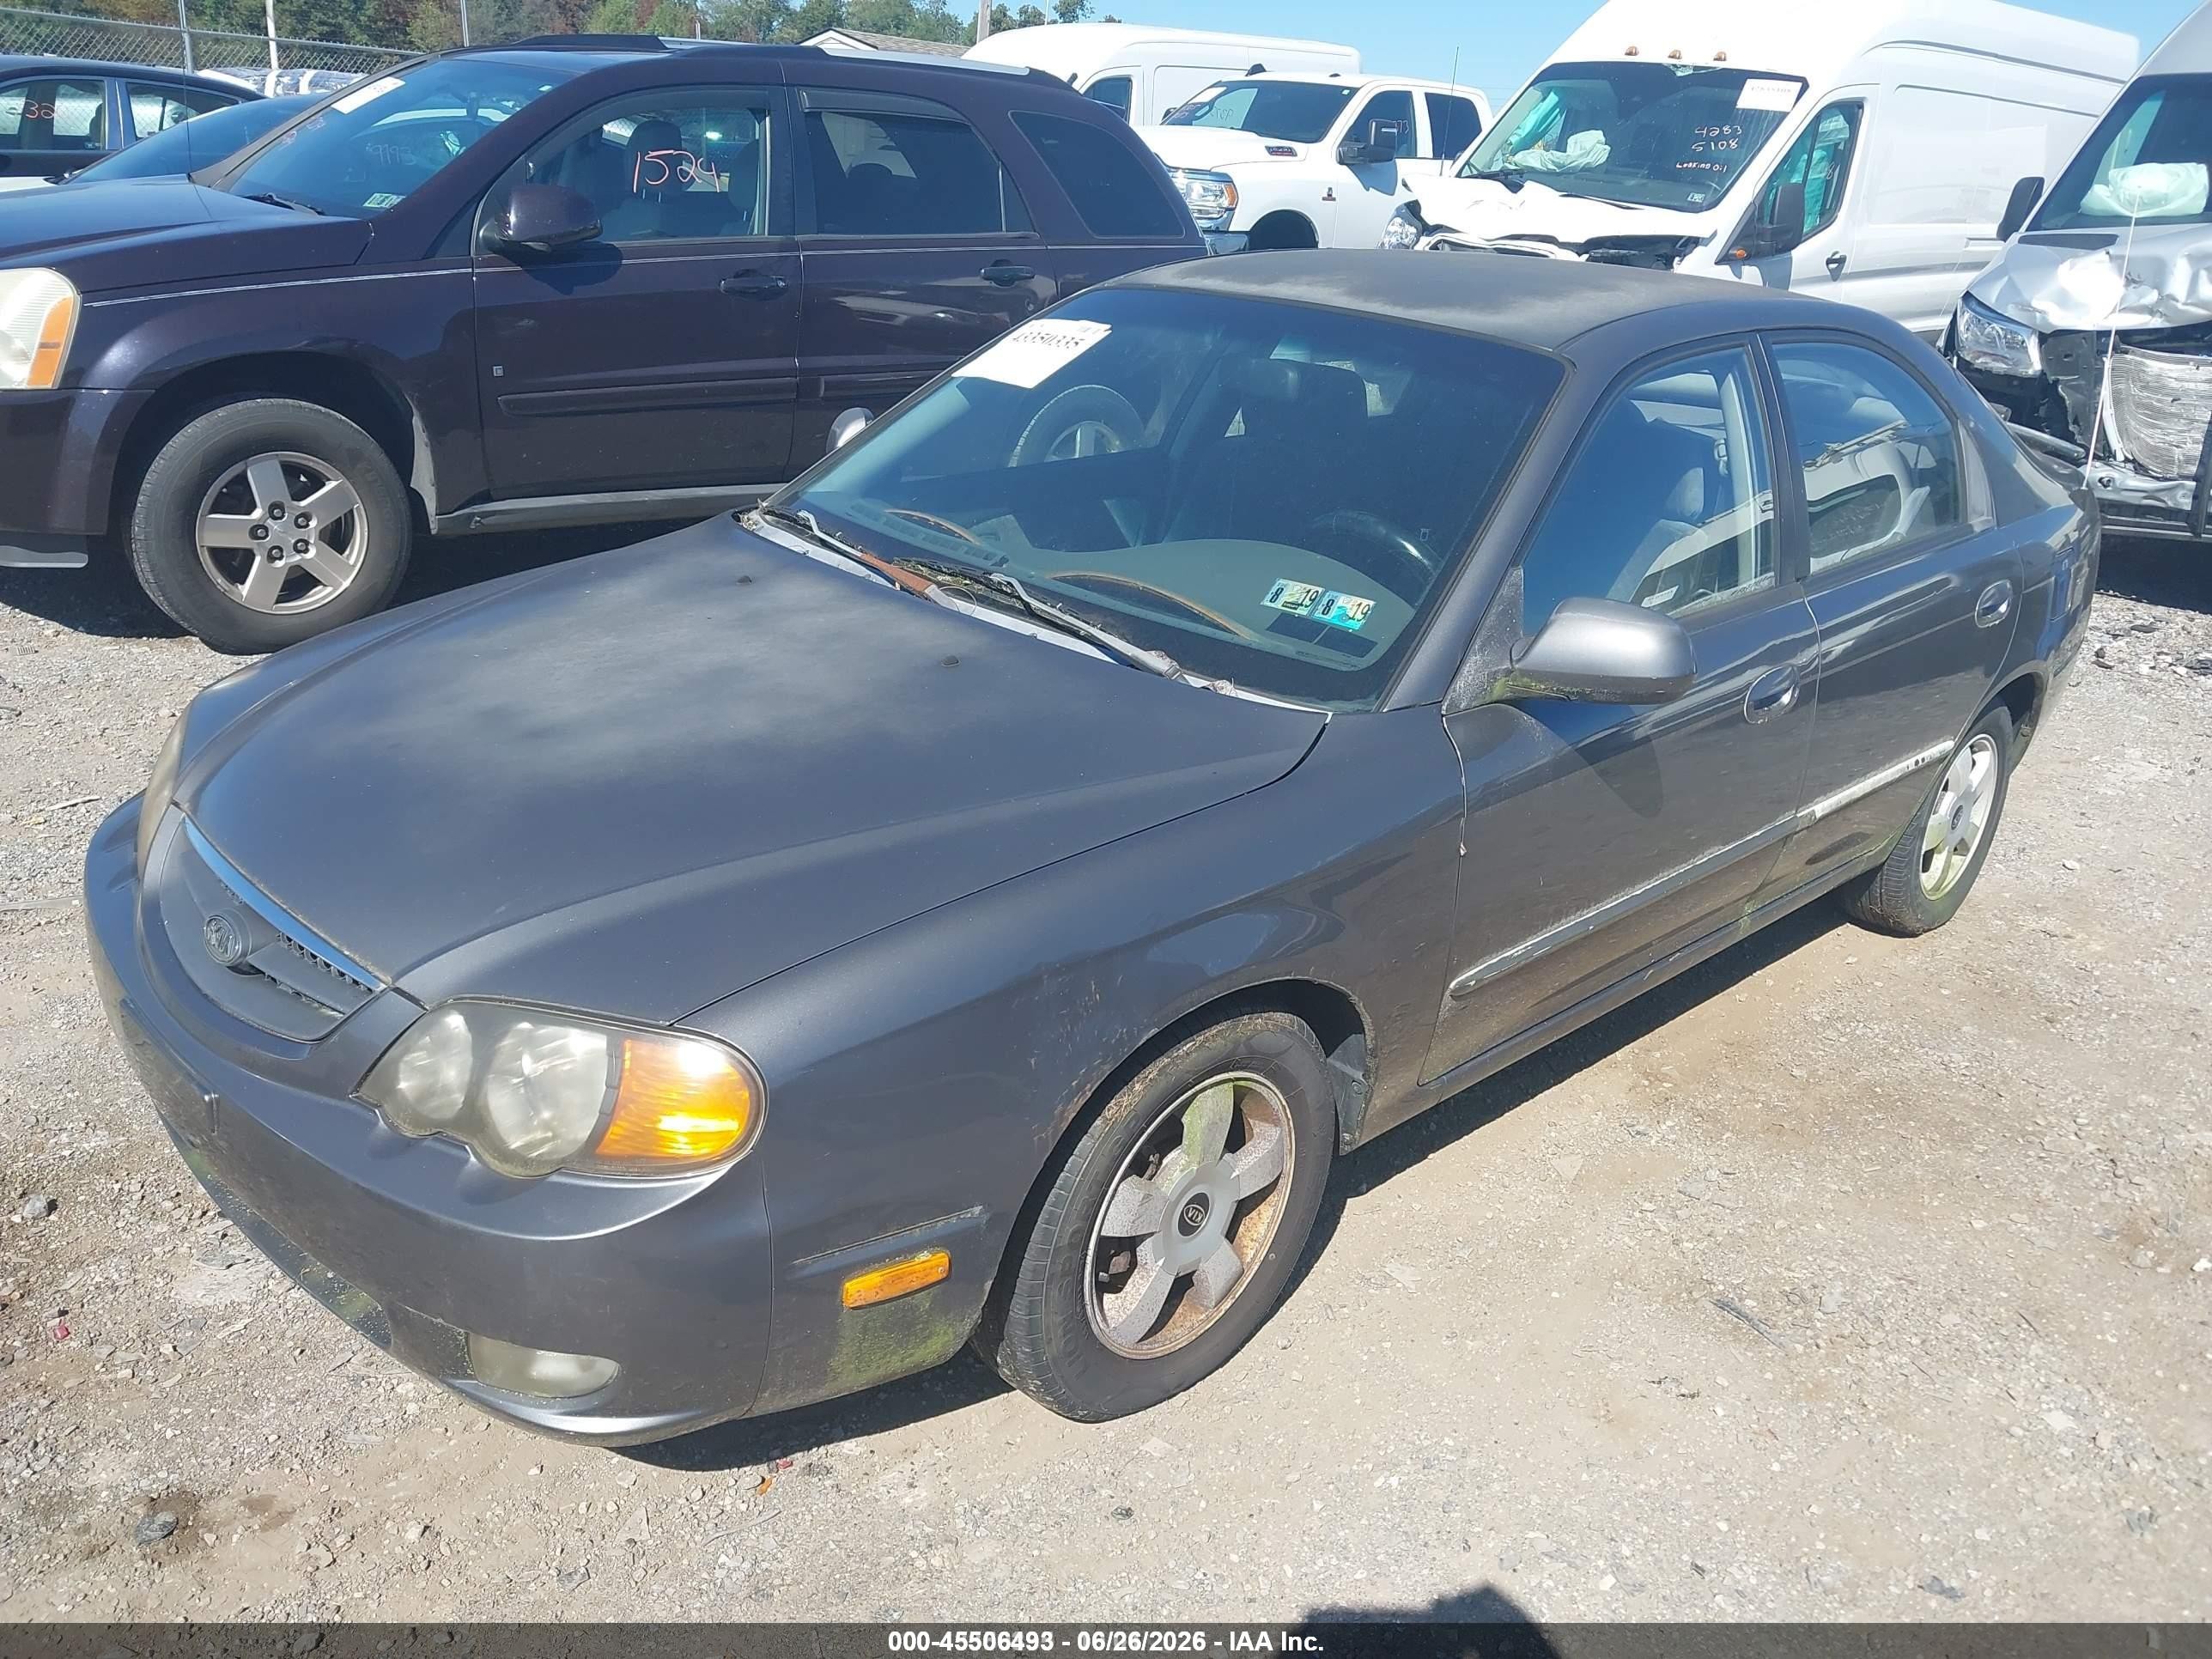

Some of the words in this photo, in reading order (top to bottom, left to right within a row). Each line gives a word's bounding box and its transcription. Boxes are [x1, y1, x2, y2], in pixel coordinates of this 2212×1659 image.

[1694, 125, 1742, 138] 4283
[1692, 138, 1739, 152] 5108
[633, 149, 720, 193] 1524
[1269, 586, 1285, 604] 8
[1298, 588, 1320, 609] 19
[1322, 599, 1335, 616] 8
[1349, 601, 1370, 622] 19
